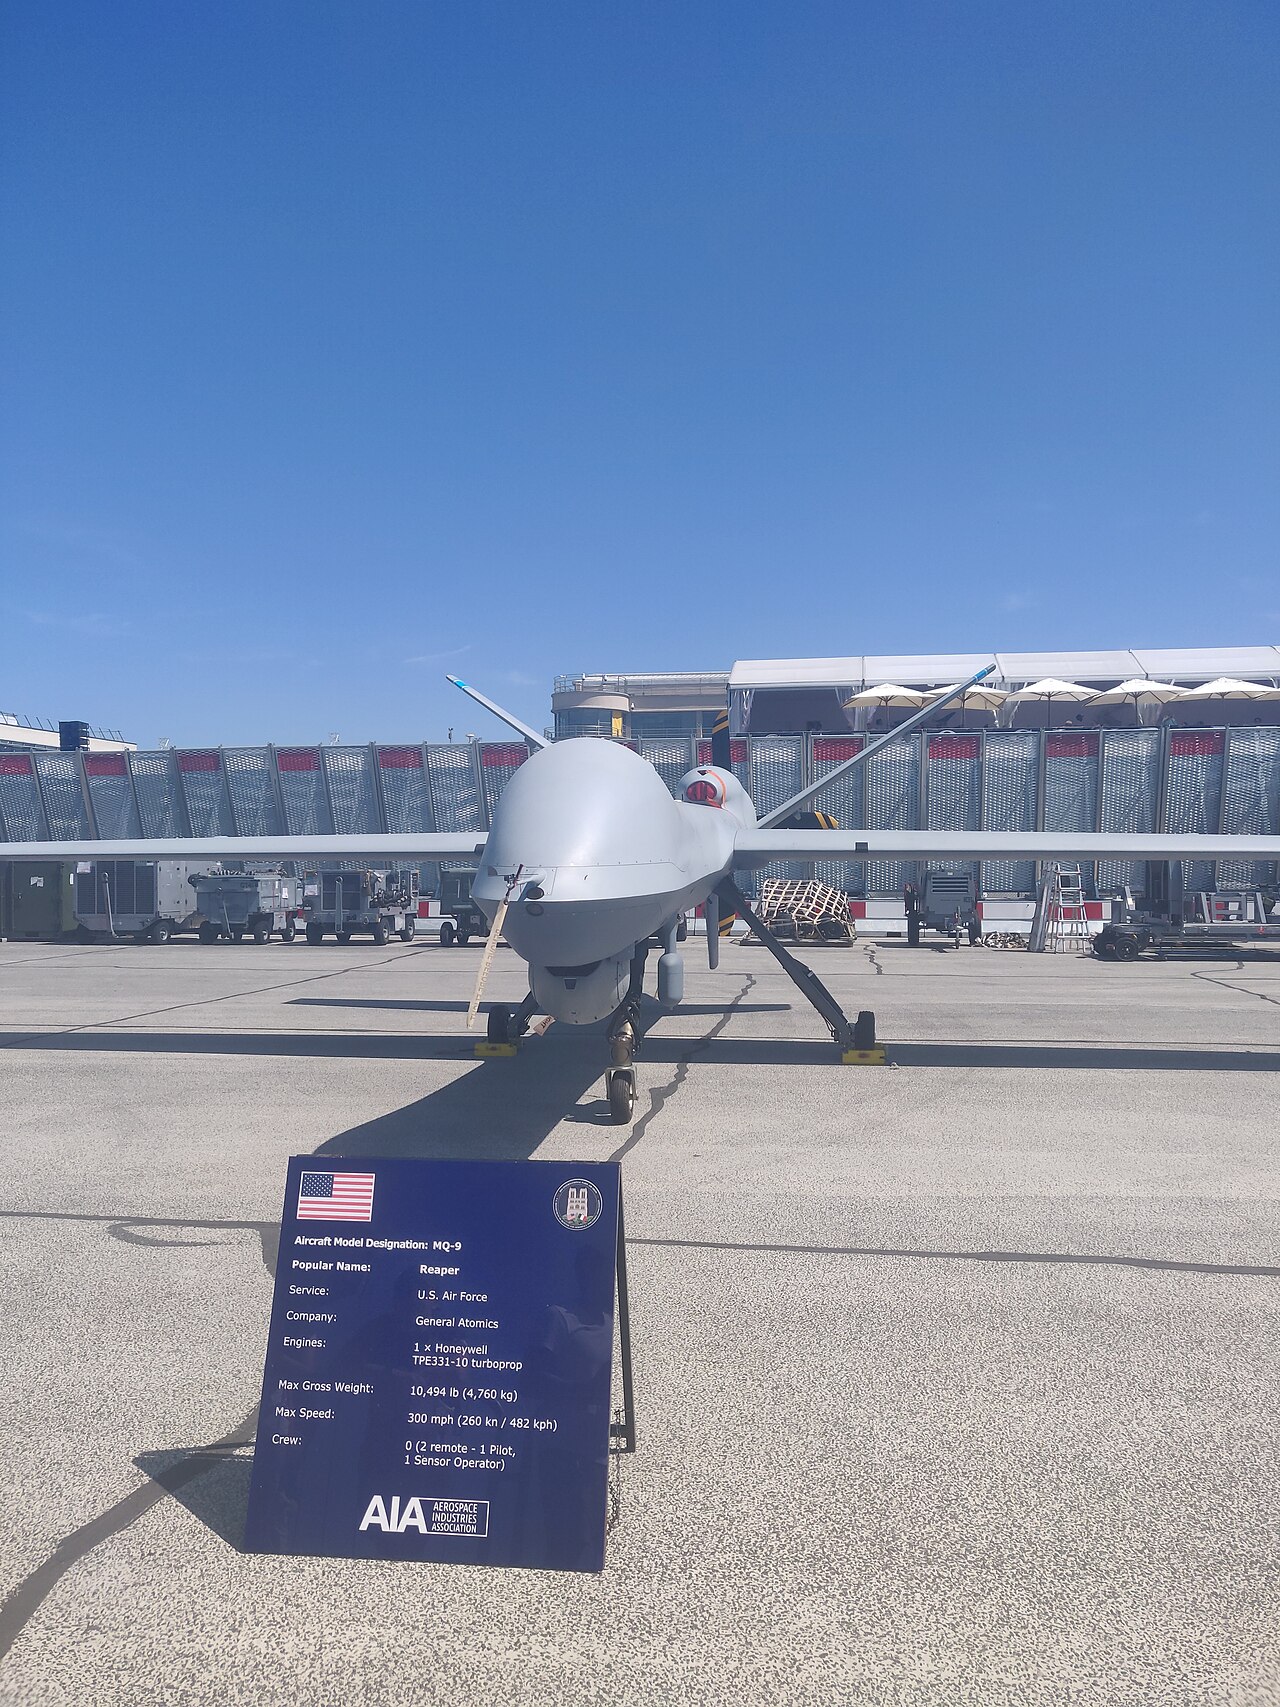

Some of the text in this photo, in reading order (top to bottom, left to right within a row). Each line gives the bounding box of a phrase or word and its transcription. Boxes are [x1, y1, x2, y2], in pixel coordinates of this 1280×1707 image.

[294, 1236, 462, 1252] Aircraft Model Designation: MQ-9
[292, 1260, 371, 1272] Popular Name:
[420, 1264, 460, 1277] Reaper
[289, 1285, 329, 1295] Service:
[418, 1290, 487, 1302] U.S. Air Force
[286, 1310, 337, 1323] Company:
[416, 1316, 498, 1329] General Atomics
[283, 1337, 326, 1349] Engines:
[414, 1342, 419, 1352] 1
[435, 1343, 487, 1356] Honeywell
[412, 1355, 522, 1371] TPE331-10 turboprop
[278, 1380, 374, 1395] Max Gross Weight:
[411, 1386, 517, 1402] 10,494 lb (4,760 kg)
[275, 1407, 335, 1420] Max Speed:
[407, 1413, 557, 1432] 300 mph (260 kn / 482 kph)
[272, 1434, 302, 1445] Crew:
[405, 1440, 412, 1451] 0
[416, 1441, 427, 1453] (2
[430, 1443, 468, 1453] remote
[480, 1444, 485, 1454] 1
[490, 1444, 515, 1458] Pilot,
[405, 1455, 505, 1471] 1 Sensor Operator)
[359, 1495, 427, 1534] AIA
[433, 1502, 478, 1514] AEROSPACE
[431, 1512, 477, 1524] INDUSTRIES
[431, 1523, 477, 1534] ASSOCIATION
